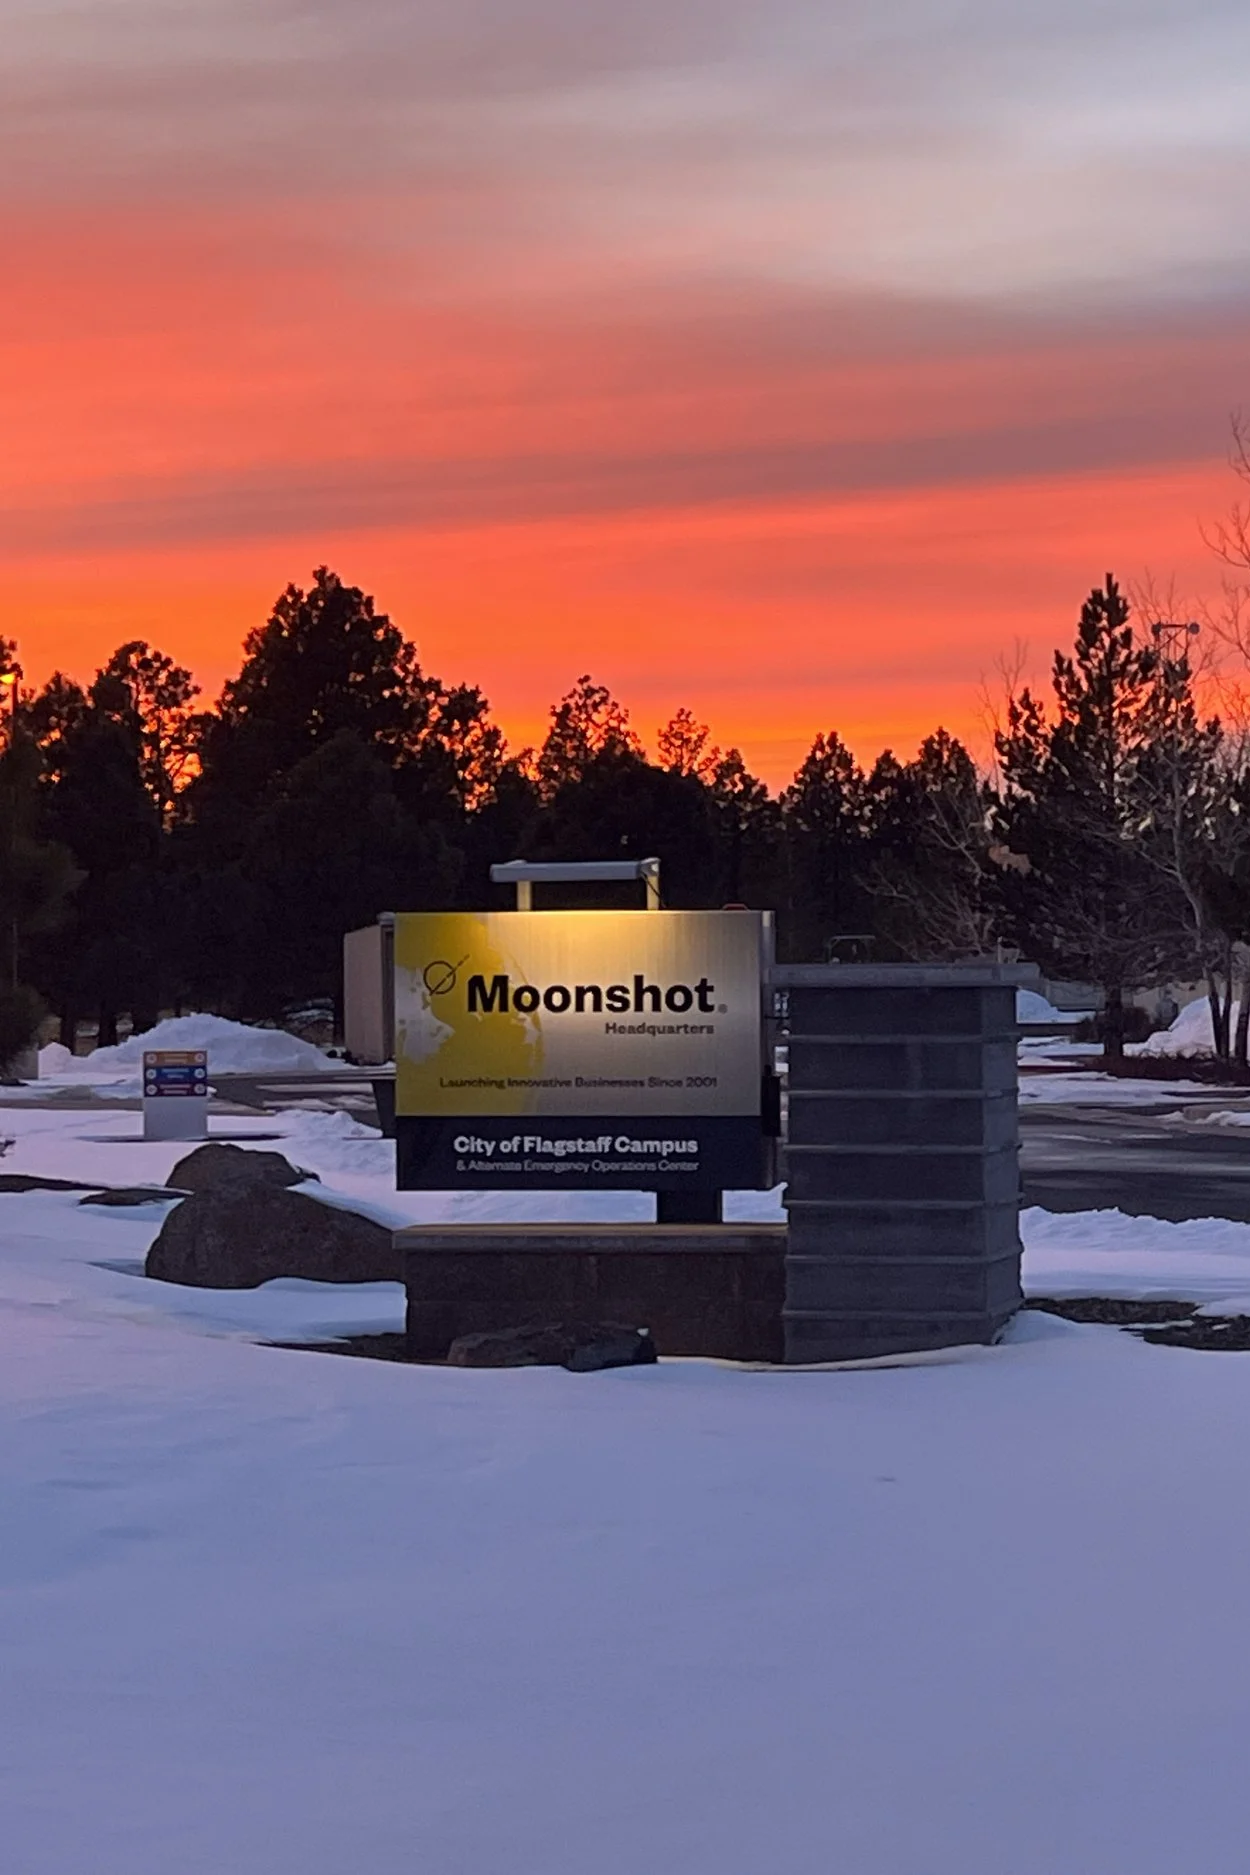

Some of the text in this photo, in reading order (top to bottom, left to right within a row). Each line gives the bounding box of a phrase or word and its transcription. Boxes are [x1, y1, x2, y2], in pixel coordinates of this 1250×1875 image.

[467, 974, 715, 1013] Moonshot
[605, 1022, 715, 1036] Headquarters
[440, 1077, 718, 1089] Launching Innovative Businesses Since 2001
[453, 1136, 699, 1156] City of Flagstaff Campus
[456, 1160, 700, 1173] & Alternate Emergency Operations Center
